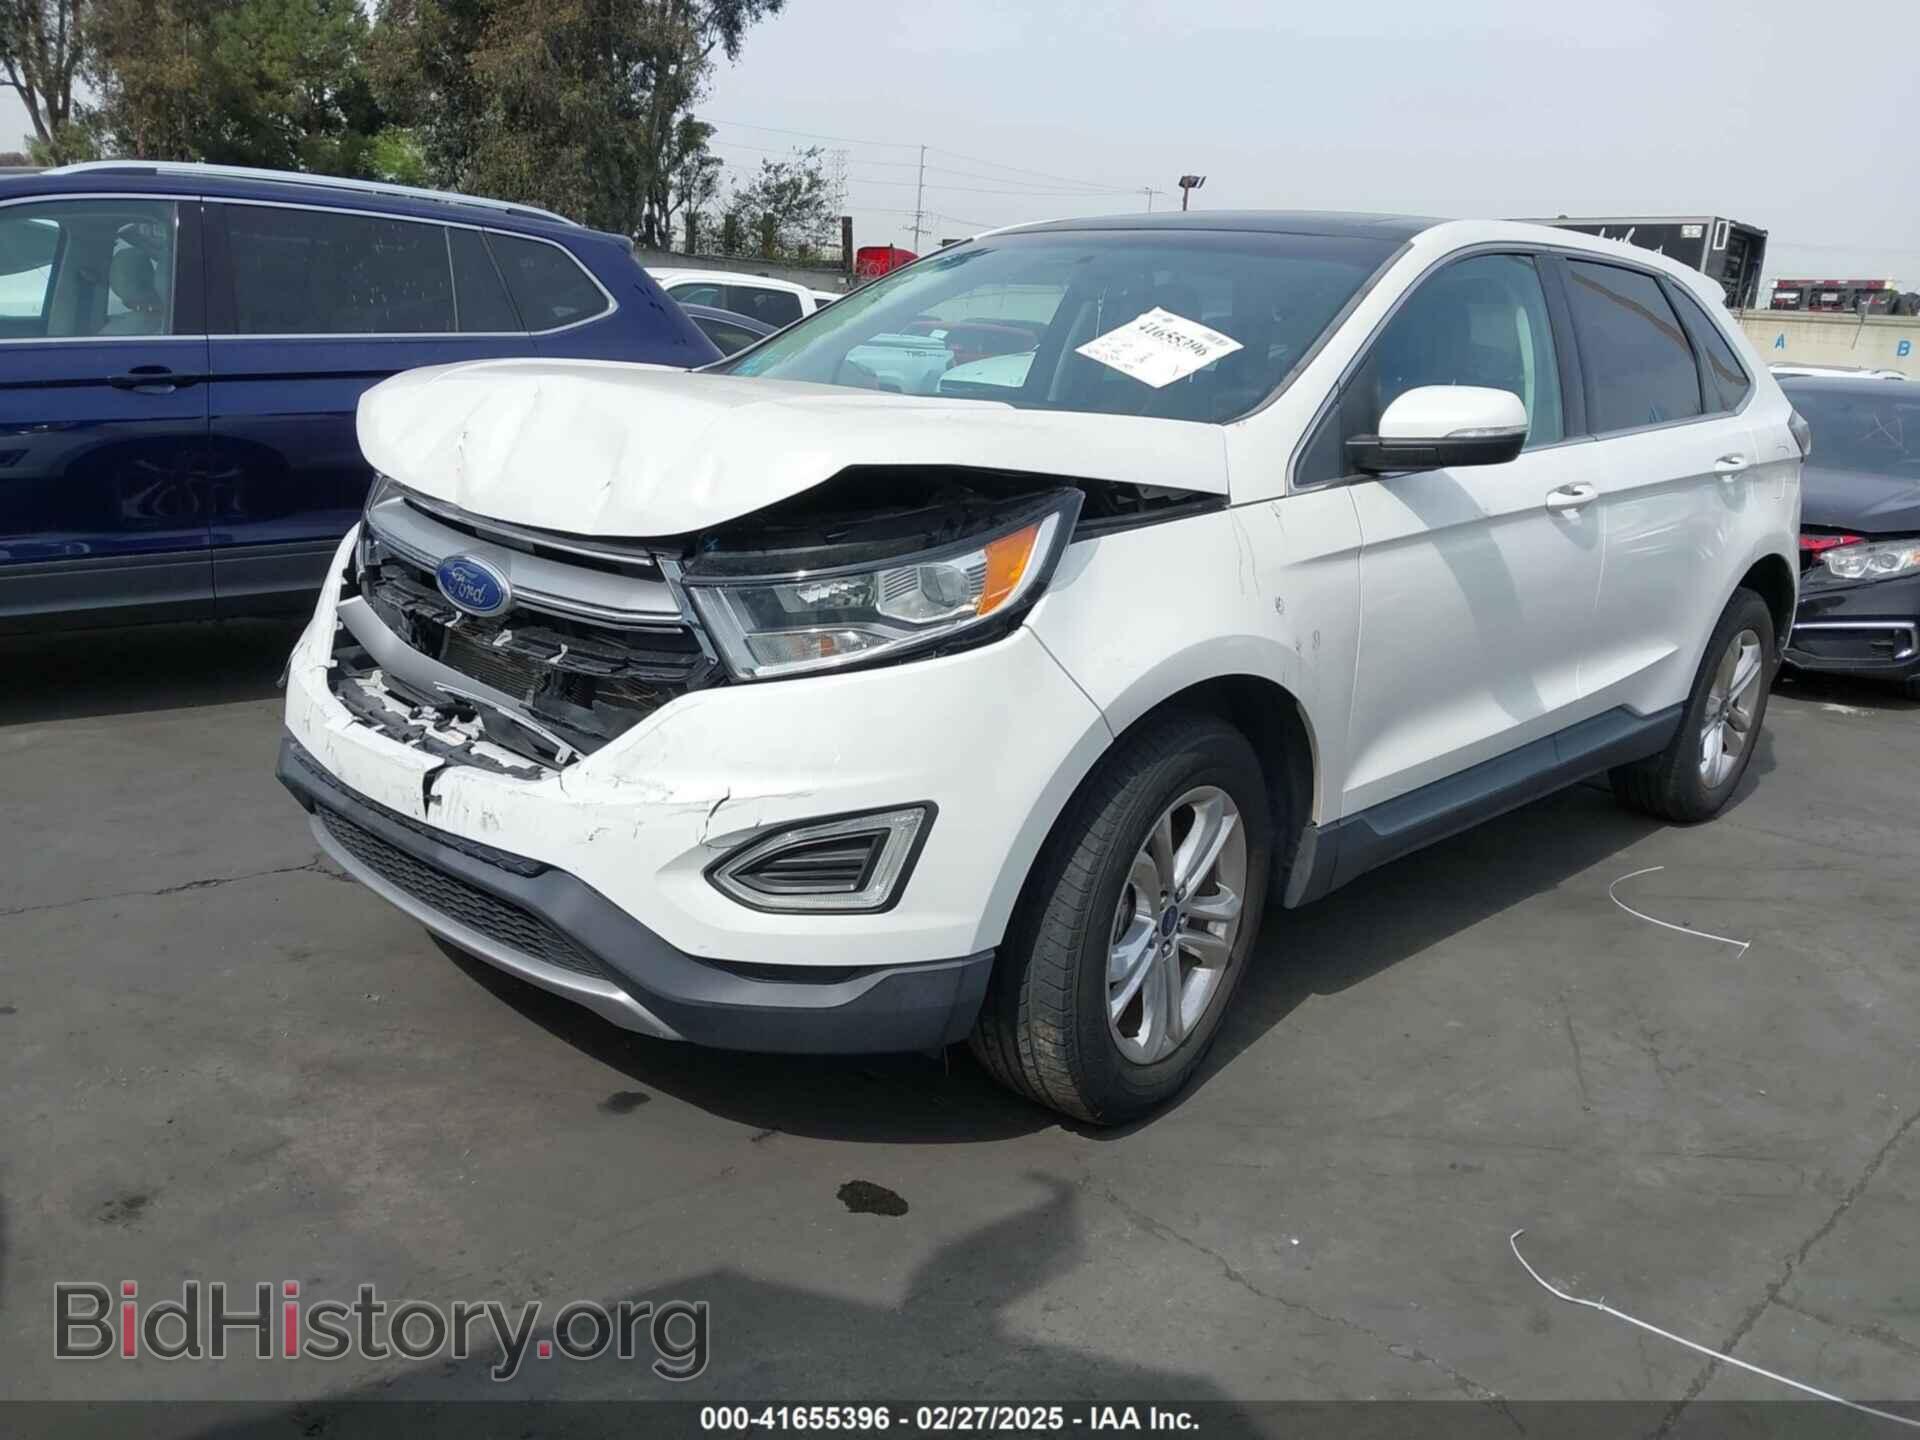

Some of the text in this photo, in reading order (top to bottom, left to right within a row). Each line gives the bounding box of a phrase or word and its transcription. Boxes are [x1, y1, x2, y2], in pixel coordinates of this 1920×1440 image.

[1774, 333, 1786, 350] A
[1896, 340, 1912, 357] B
[447, 565, 489, 605] Ford
